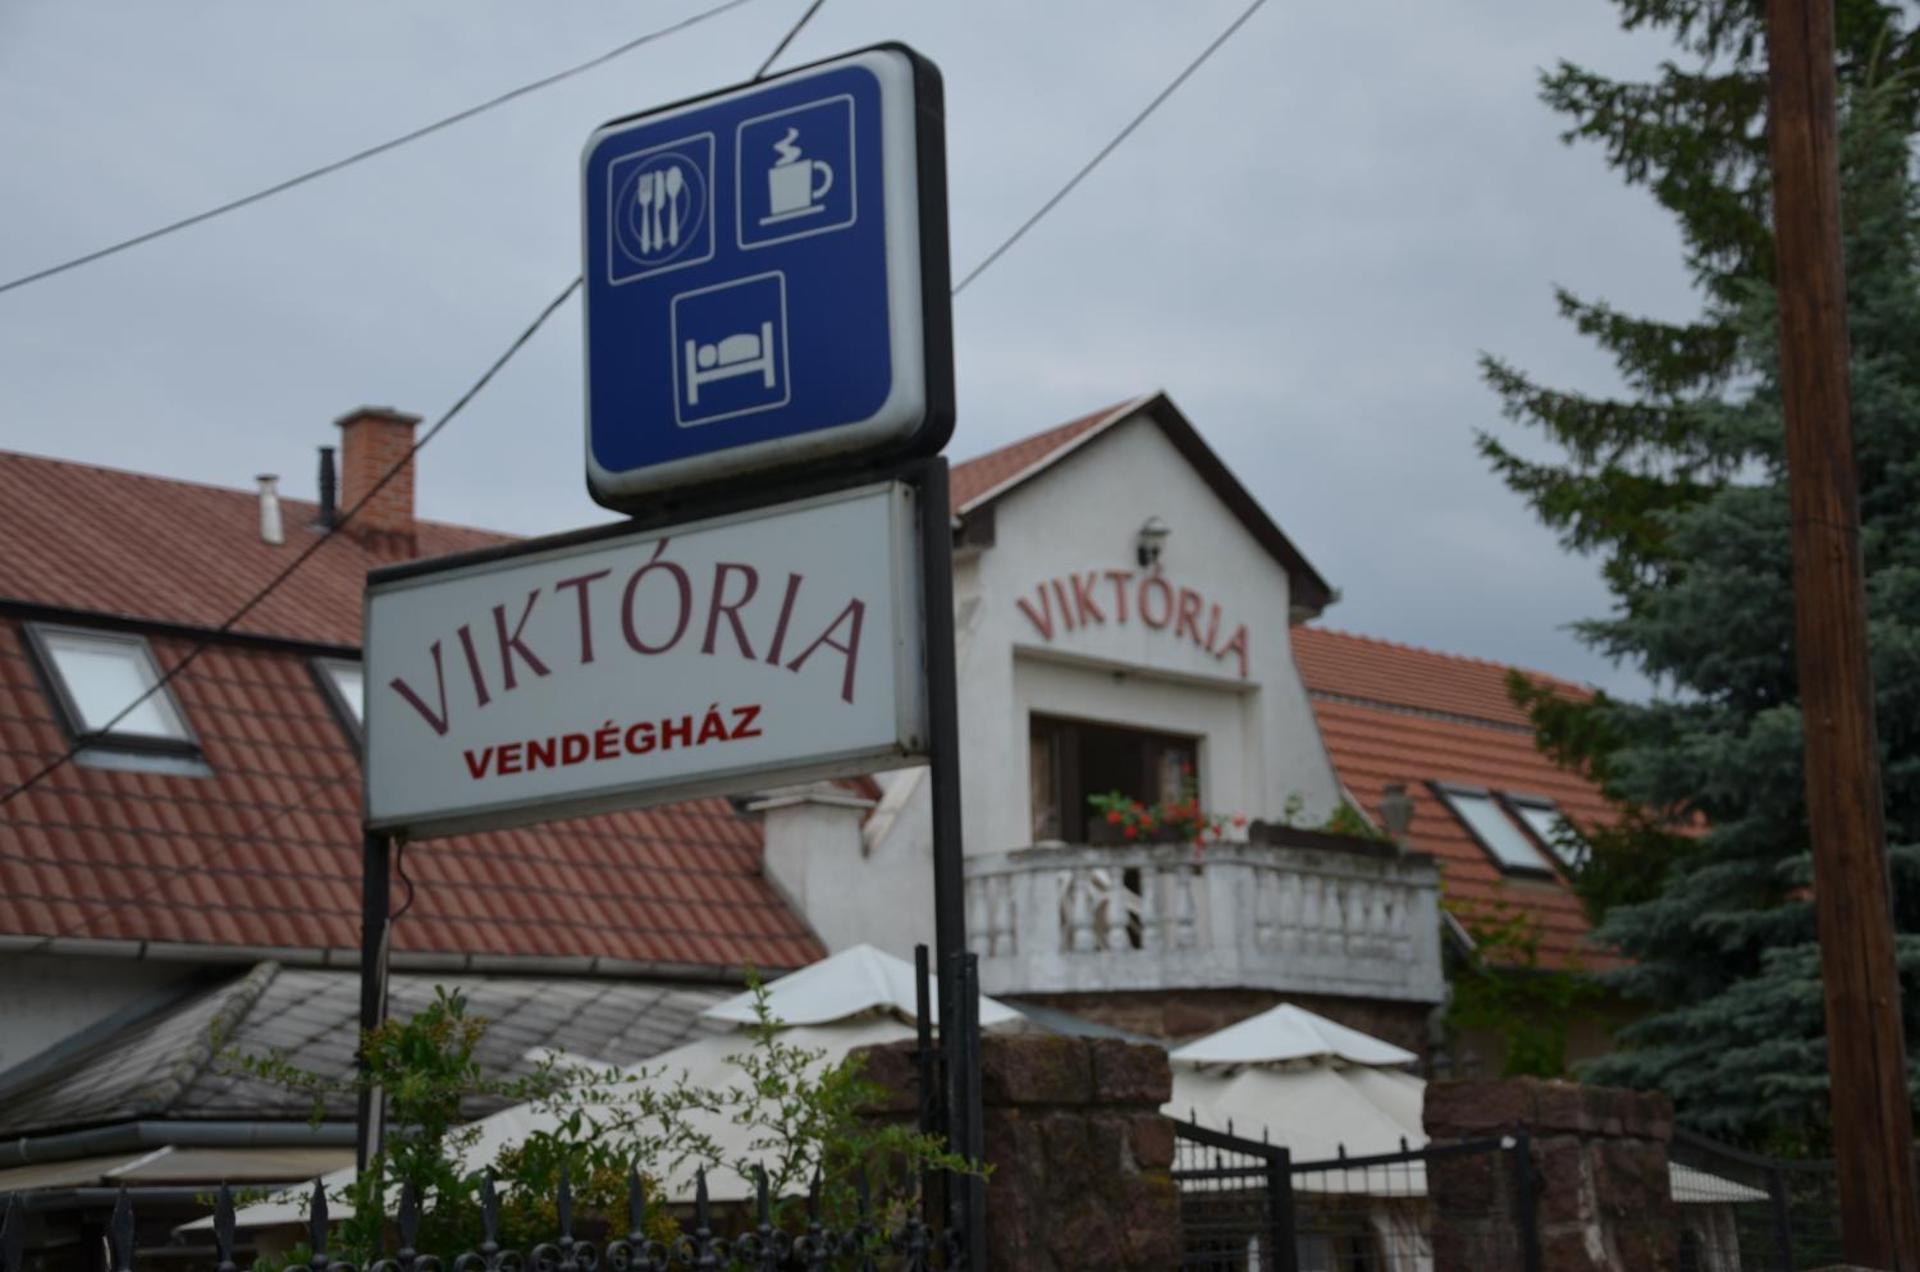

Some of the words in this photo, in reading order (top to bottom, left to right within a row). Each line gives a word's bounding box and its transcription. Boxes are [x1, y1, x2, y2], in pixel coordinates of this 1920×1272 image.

[388, 537, 866, 737] VIKTÓRIA
[1015, 561, 1249, 678] VIKTÓRIA
[463, 703, 763, 780] VENDÉGHÁZ
